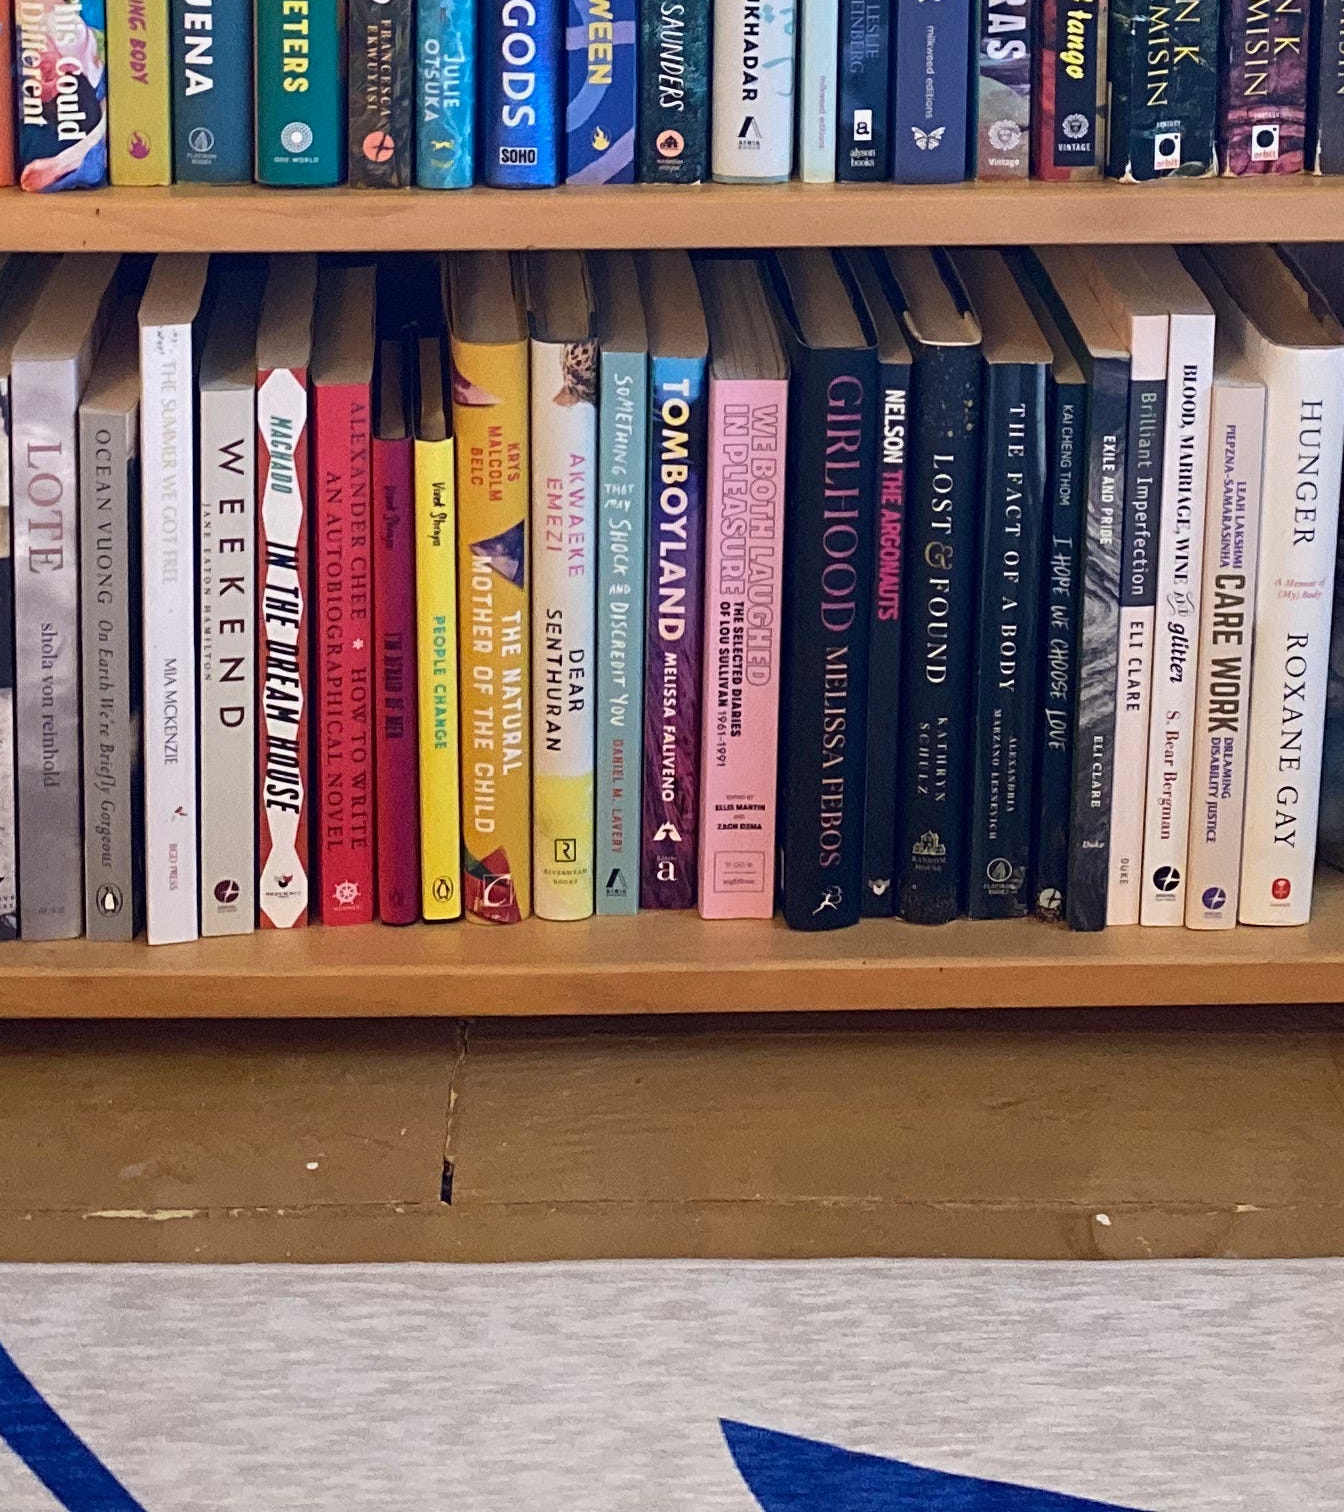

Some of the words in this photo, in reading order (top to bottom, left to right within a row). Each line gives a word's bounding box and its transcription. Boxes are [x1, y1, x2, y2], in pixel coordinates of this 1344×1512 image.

[500, 0, 536, 128] GODS
[659, 3, 687, 110] SAUNDERS
[1060, 10, 1093, 80] tango
[502, 147, 536, 165] SOHO
[1057, 142, 1091, 152] VINTAGE
[883, 390, 906, 464] NELSON
[1009, 403, 1026, 458] THE
[1139, 393, 1156, 467] Brilliant
[28, 442, 64, 573] LOTE
[657, 378, 690, 638] TOMBOYLAND
[821, 375, 863, 631] GIRLHOOD
[882, 471, 902, 506] THE
[931, 453, 954, 534] LOST
[1006, 471, 1023, 537] FACT
[1294, 400, 1322, 545] HUNGER
[266, 542, 298, 569] IN
[879, 510, 901, 621] ARGONAUTS
[924, 543, 954, 570] &
[1003, 551, 1019, 583] OF
[1132, 478, 1152, 595] Imperfection
[217, 436, 245, 730] WEEKEND
[266, 585, 300, 628] THE
[471, 556, 493, 653] MOTHER
[1002, 596, 1018, 612] A
[1212, 574, 1244, 645] CARE
[434, 615, 445, 675] PEOPLE
[502, 612, 520, 657] THE
[927, 578, 950, 685] FOUND
[1000, 624, 1017, 693] BODY
[1129, 621, 1142, 651] ELI
[266, 640, 300, 725] DREAM
[473, 666, 491, 694] OF
[545, 608, 564, 753] SENTHURAN
[568, 649, 585, 714] DEAR
[662, 652, 676, 716] MELISSA
[820, 647, 848, 767] MELISSA
[1125, 657, 1140, 712] CLARE
[1208, 656, 1242, 734] WORK
[1280, 633, 1308, 772] ROXANE
[433, 684, 448, 751] CHANGE
[473, 707, 493, 749] THE
[502, 667, 523, 776] NATURAL
[265, 736, 299, 814] HOUSE
[473, 762, 495, 833] CHILD
[662, 722, 676, 802] FALIVENO
[819, 778, 844, 867] FEBOS
[1274, 786, 1298, 849] GAY
